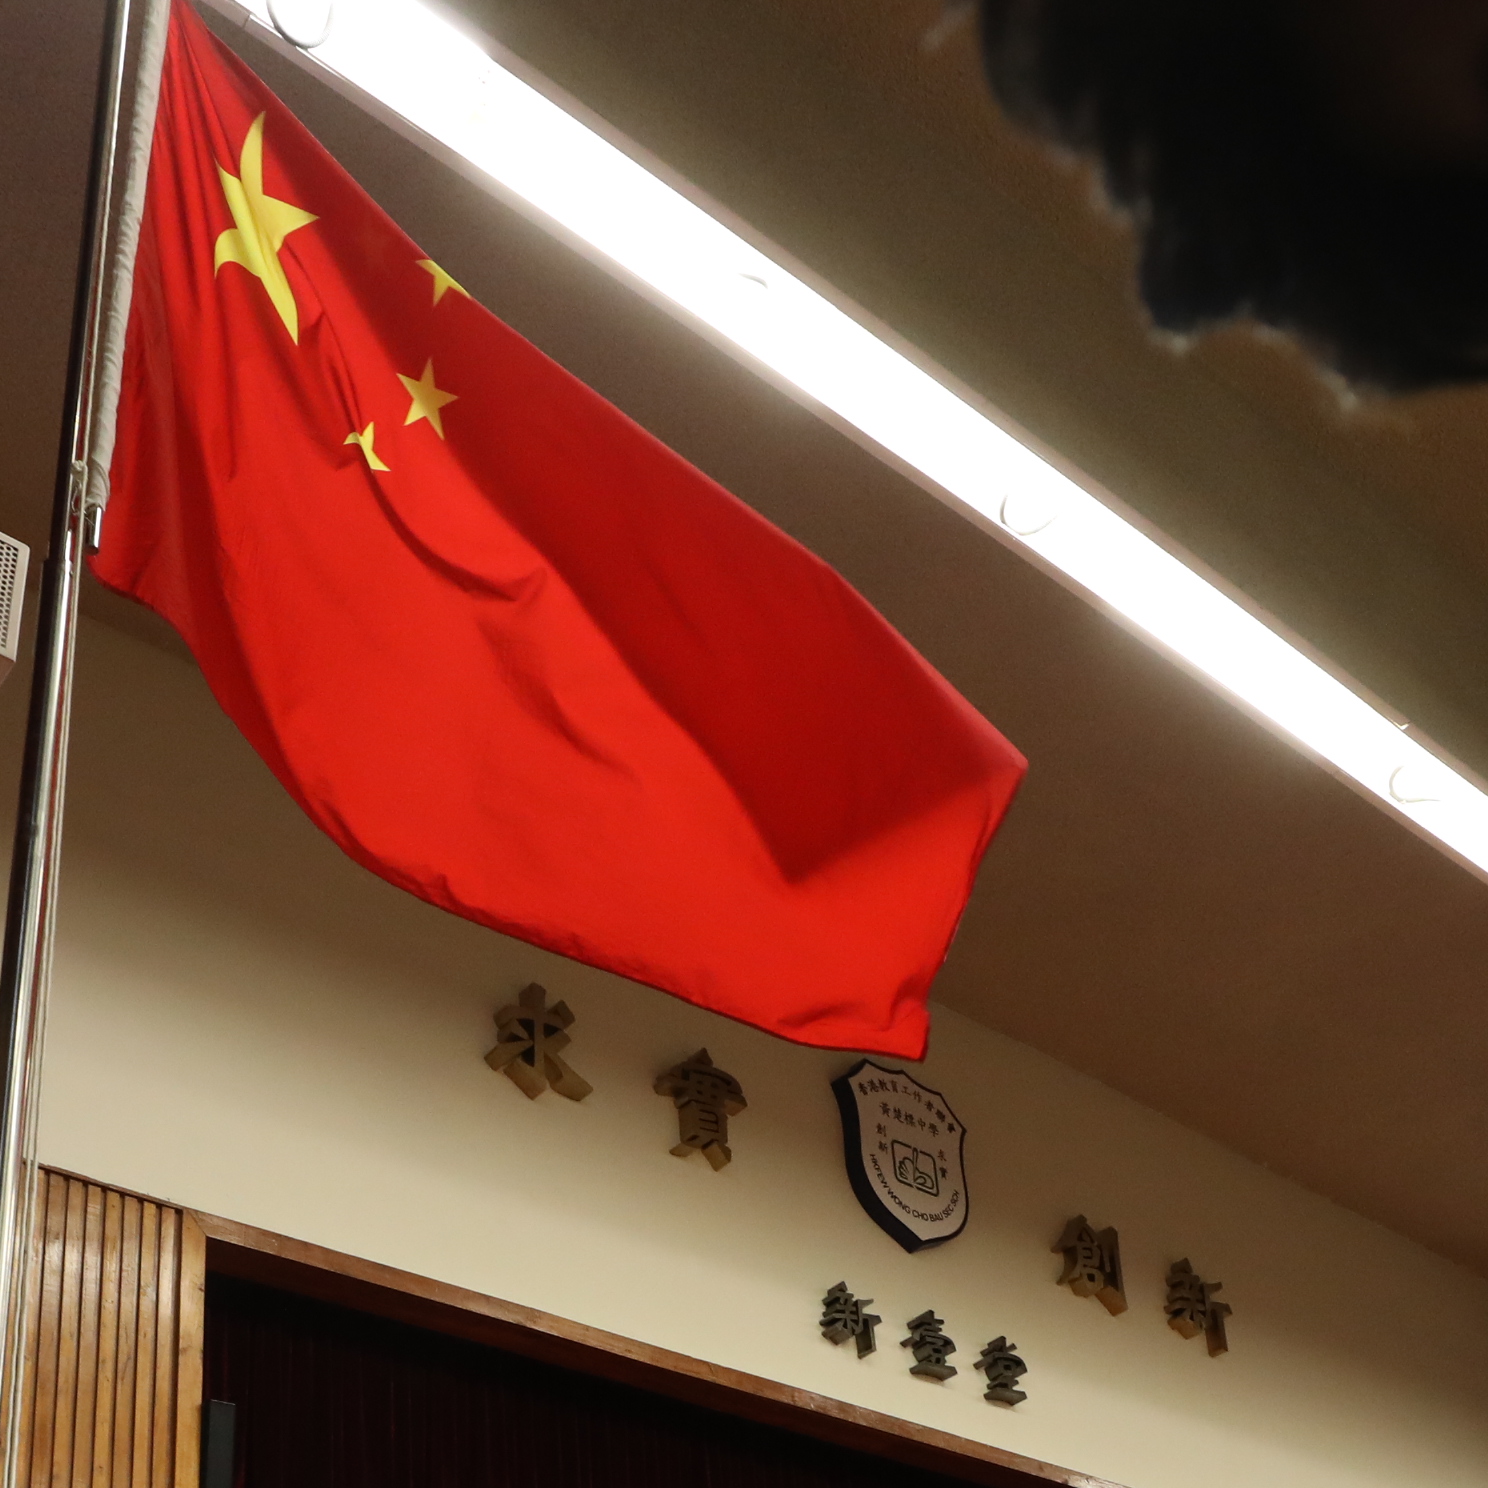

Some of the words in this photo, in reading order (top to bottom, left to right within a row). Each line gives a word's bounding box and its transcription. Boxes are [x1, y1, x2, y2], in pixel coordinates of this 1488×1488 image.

[483, 982, 748, 1172] 求實
[1050, 1213, 1233, 1358] 創新
[887, 1188, 911, 1214] WONG
[912, 1209, 929, 1221] CHO
[929, 1211, 944, 1222] BAU
[942, 1204, 954, 1218] SEC
[950, 1189, 960, 1207] SCH
[819, 1281, 1028, 1406] 新壹堂
